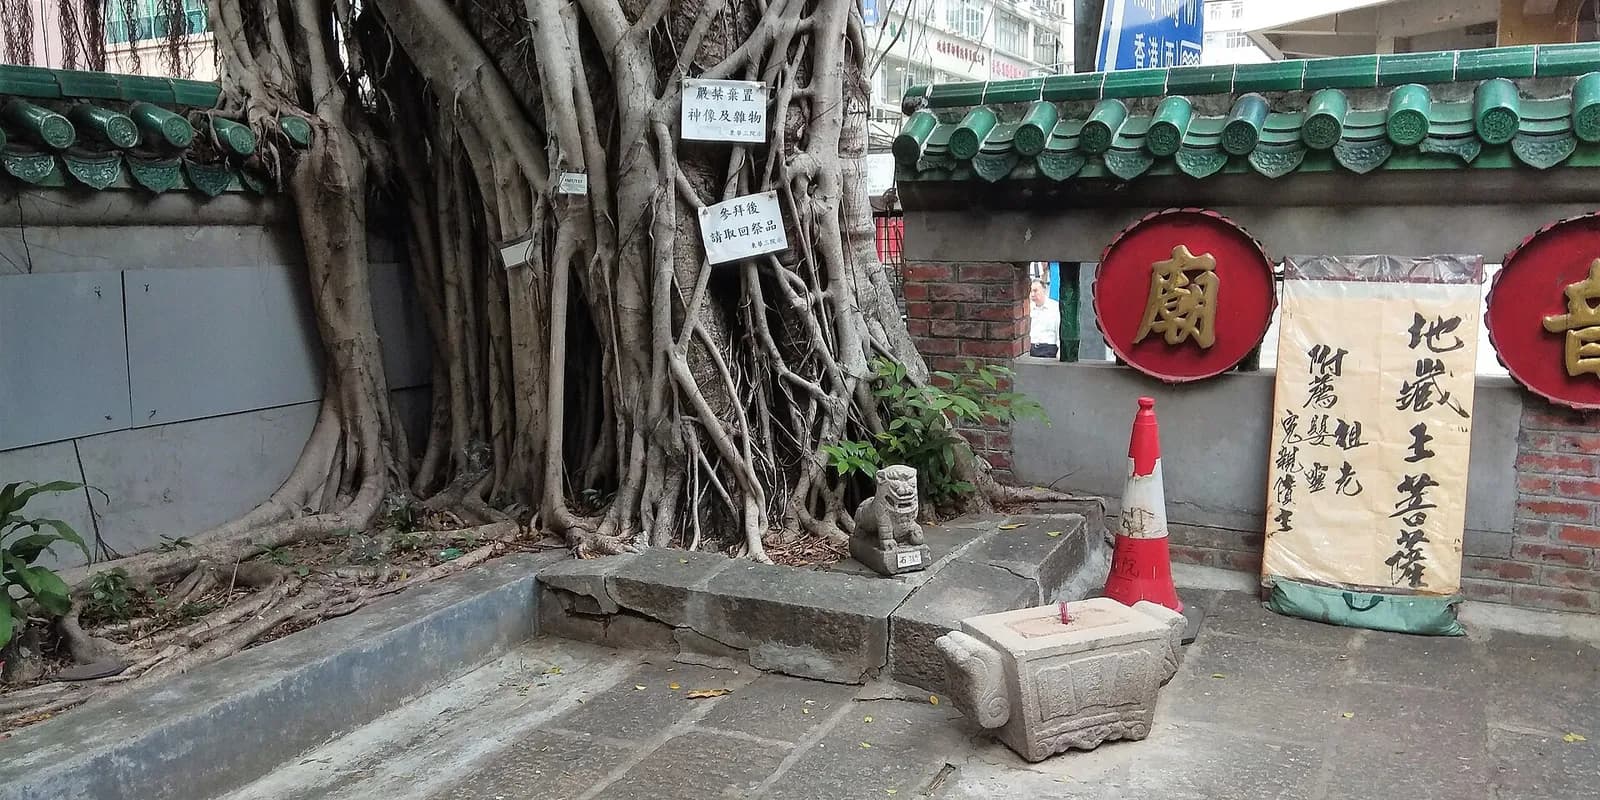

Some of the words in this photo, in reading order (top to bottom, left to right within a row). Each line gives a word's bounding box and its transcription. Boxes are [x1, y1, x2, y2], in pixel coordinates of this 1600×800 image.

[1133, 0, 1156, 20] ng
[695, 86, 754, 102] 嚴禁棄置
[687, 108, 762, 124] 神像及雜物
[719, 201, 761, 221] 參拜後
[709, 219, 778, 243] 請取回祭品
[1132, 244, 1220, 350] 廟
[1385, 312, 1471, 588] 地藏王菩薩
